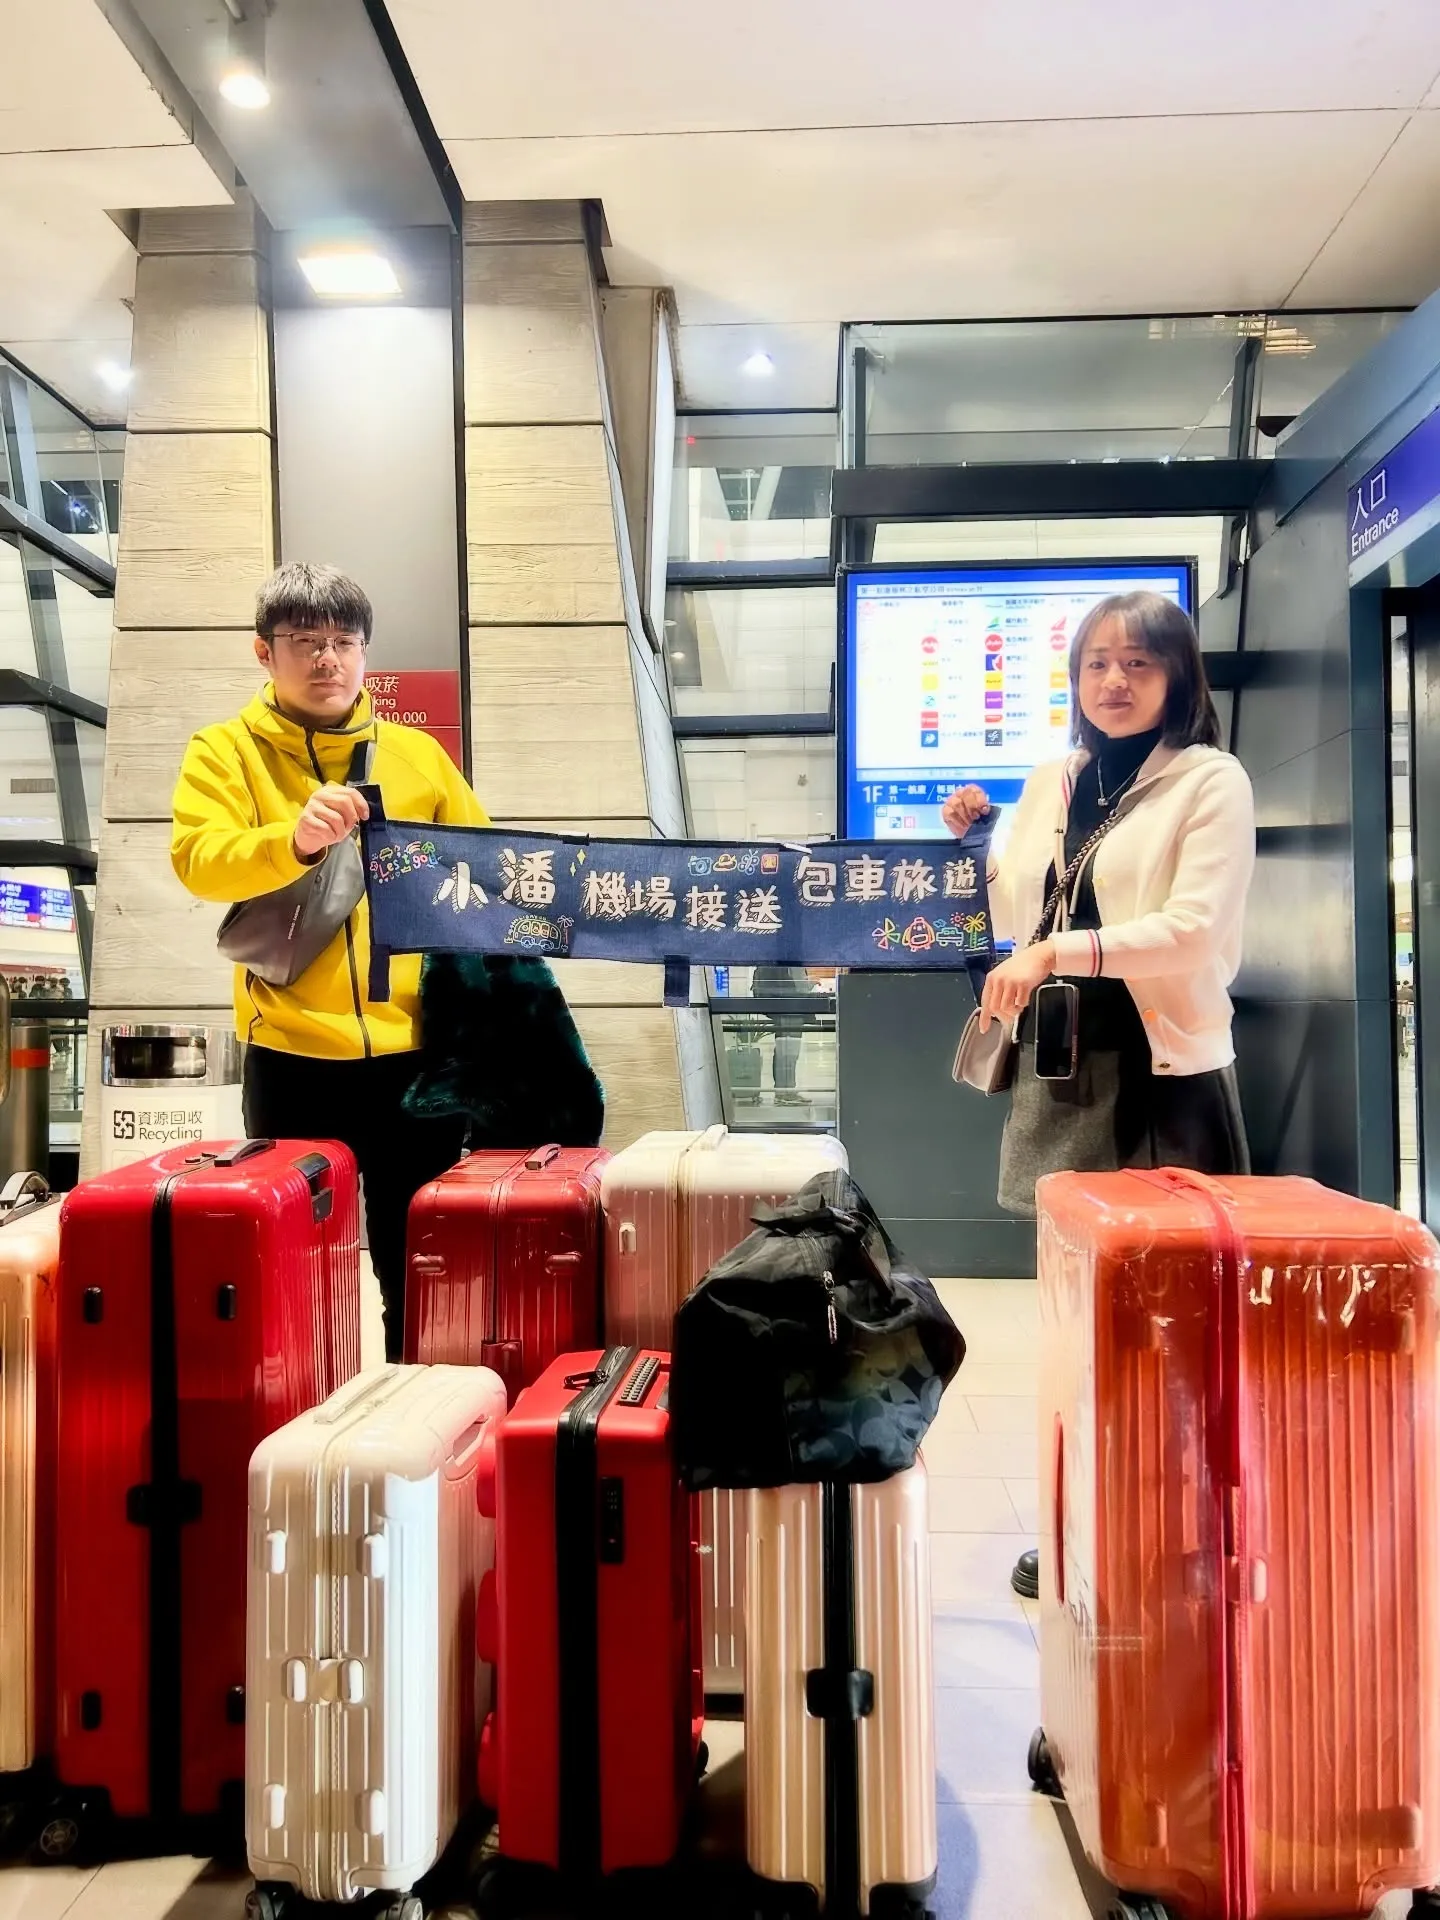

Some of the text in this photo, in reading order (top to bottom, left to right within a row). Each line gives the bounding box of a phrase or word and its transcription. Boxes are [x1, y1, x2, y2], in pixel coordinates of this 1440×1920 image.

[1352, 469, 1386, 530] 入口
[1351, 507, 1399, 557] Entrance
[862, 785, 884, 803] 1F
[435, 848, 978, 932] 小潘 機場接送 包車旅遊
[138, 1110, 204, 1126] 資源回收
[139, 1126, 203, 1144] Recycling
